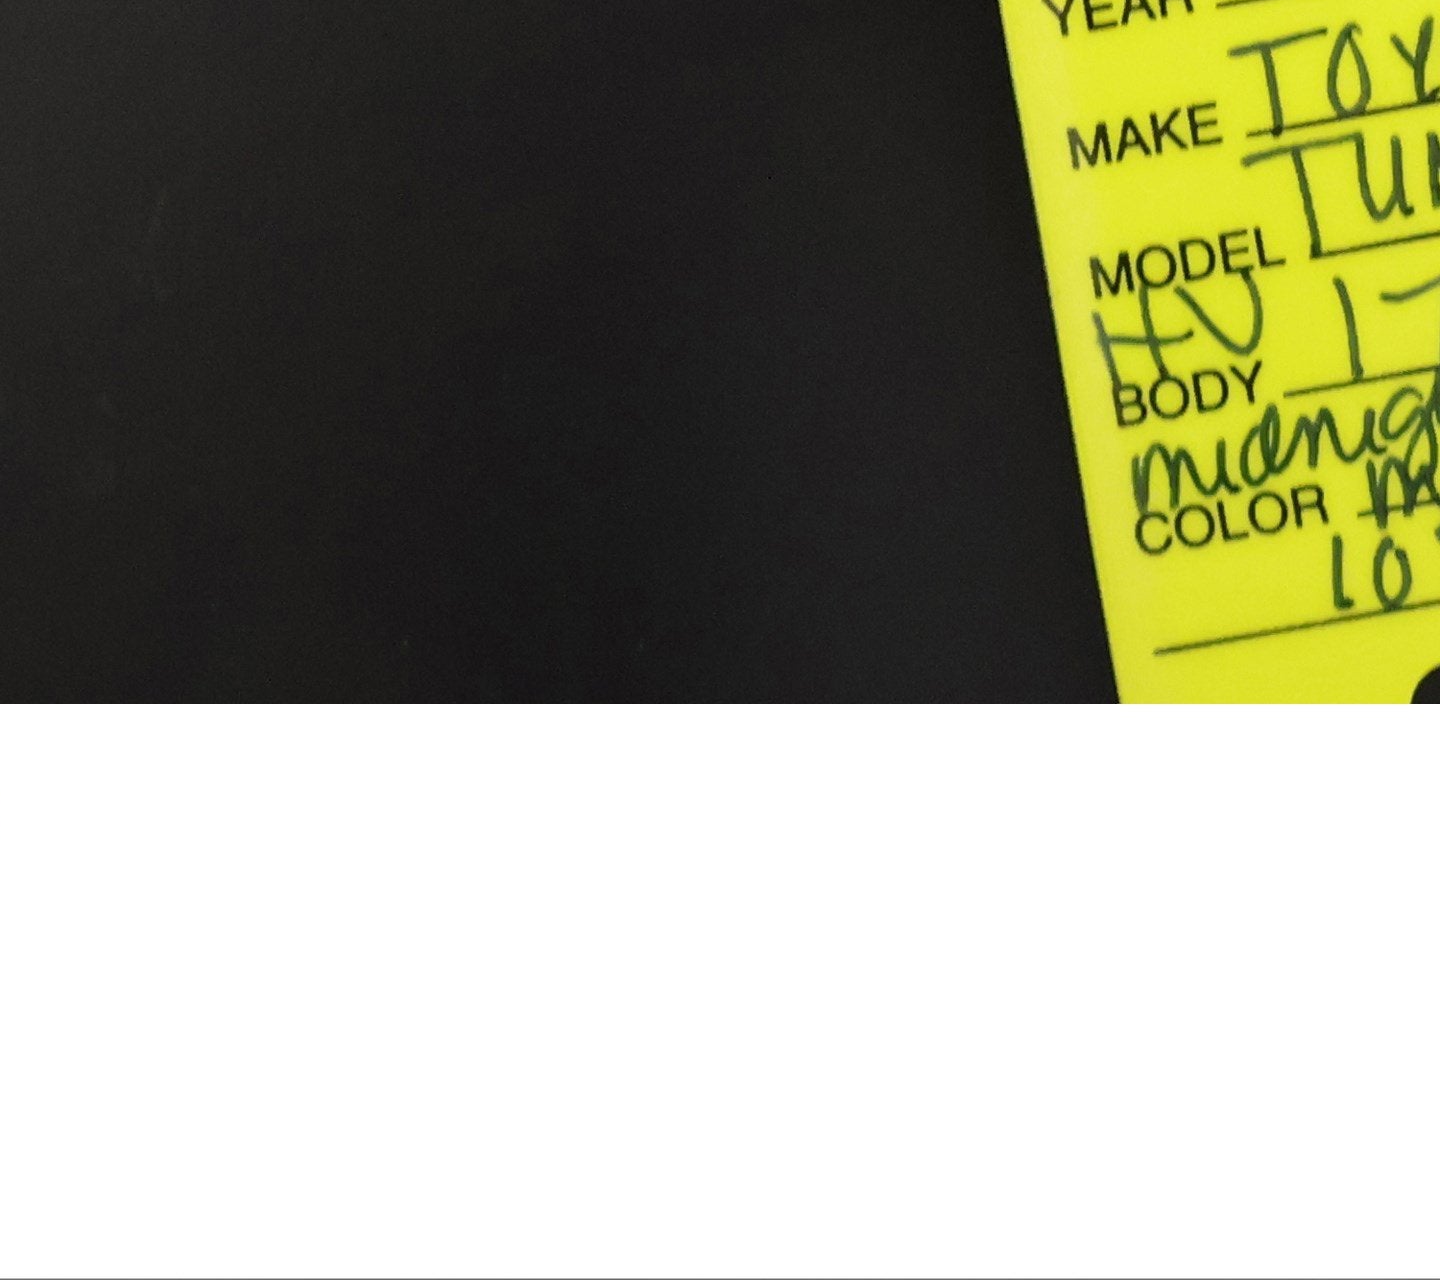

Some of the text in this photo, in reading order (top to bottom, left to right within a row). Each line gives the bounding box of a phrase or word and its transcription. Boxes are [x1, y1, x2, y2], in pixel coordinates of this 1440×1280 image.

[1067, 102, 1223, 169] MAKE
[1090, 226, 1287, 299] MODEL
[1117, 360, 1263, 428] BODY
[1134, 485, 1329, 555] COLOR
